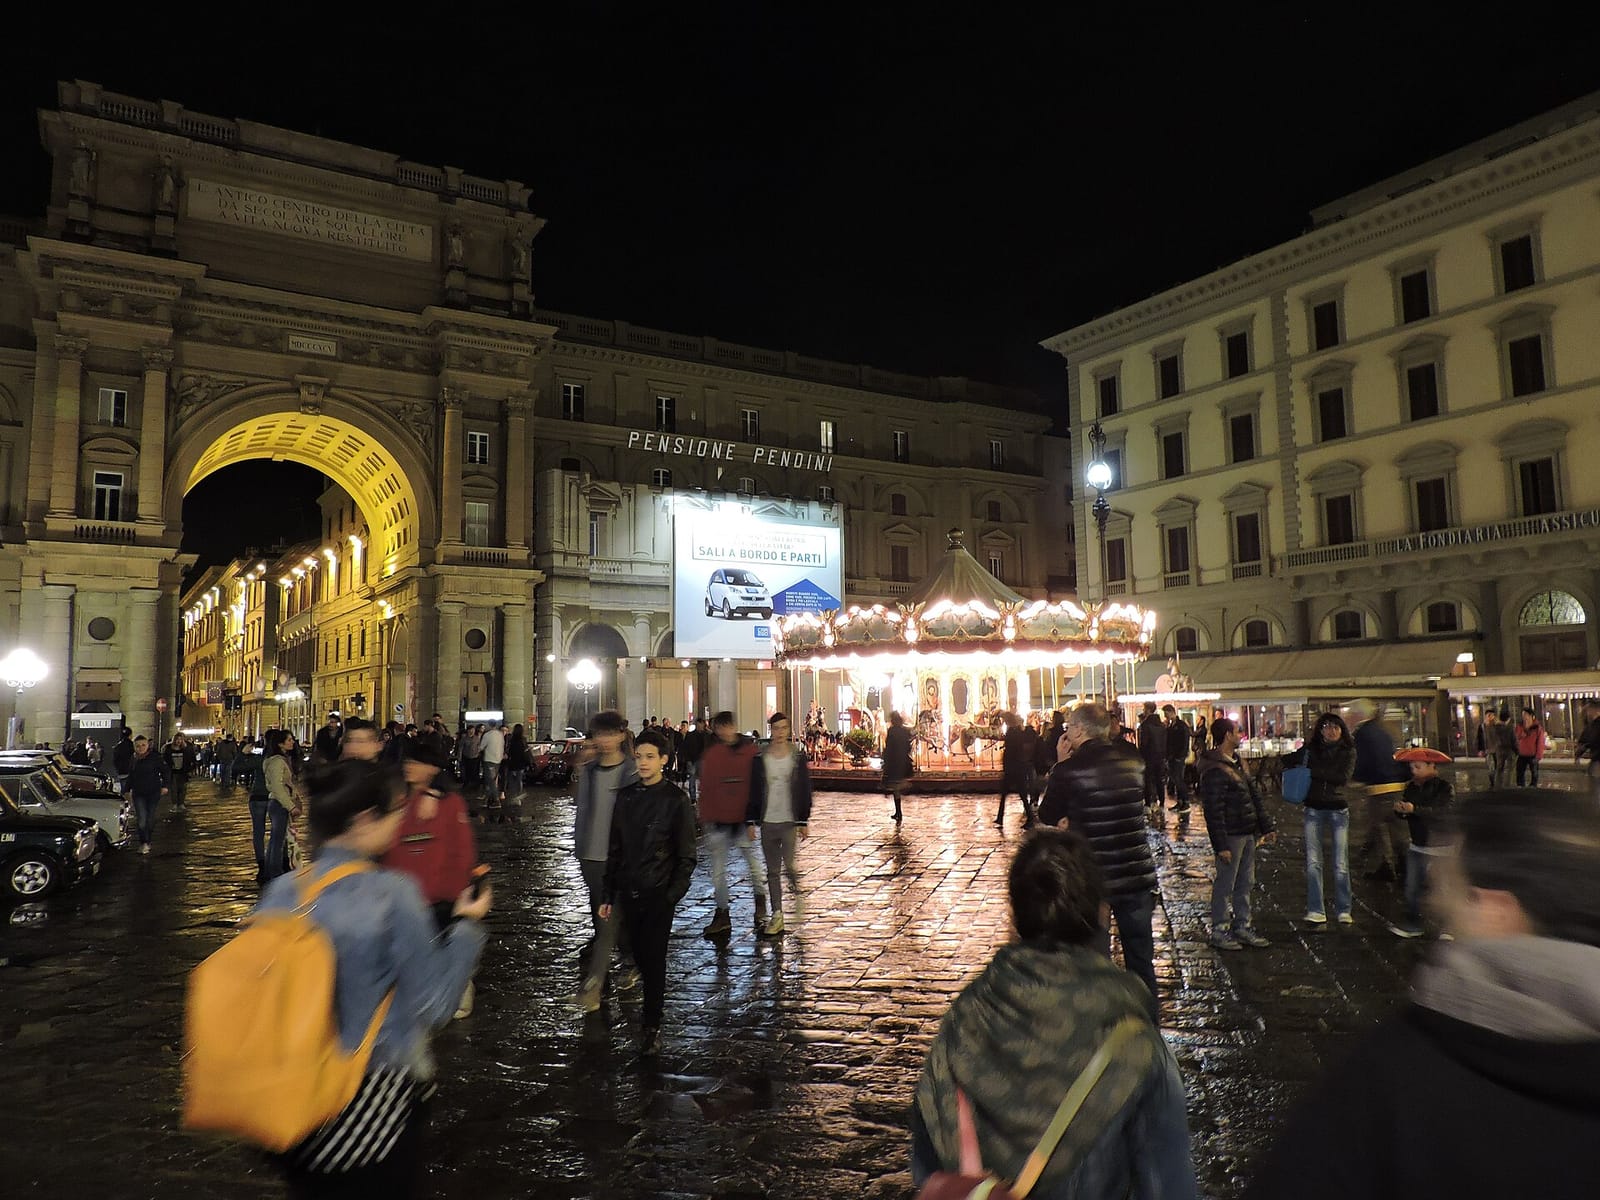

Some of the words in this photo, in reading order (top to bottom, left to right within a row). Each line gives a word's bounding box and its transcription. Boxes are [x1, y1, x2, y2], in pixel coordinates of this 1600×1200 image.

[217, 198, 238, 211] DA
[243, 203, 319, 226] SECOLARE
[273, 199, 330, 217] CENTRO
[336, 211, 382, 229] DELLA
[218, 210, 227, 219] A
[232, 212, 267, 228] VITA
[273, 221, 321, 239] NUOVA
[326, 231, 409, 253] RESTITUITO
[627, 431, 736, 461] PENSIONE
[752, 447, 834, 472] PENDINI
[1396, 536, 1412, 553] LA
[1419, 524, 1501, 550] FONDIARIA
[698, 545, 725, 557] SALI
[728, 548, 736, 558] A
[739, 548, 778, 561] BORDO
[780, 551, 788, 562] E
[789, 552, 822, 565] PARTI
